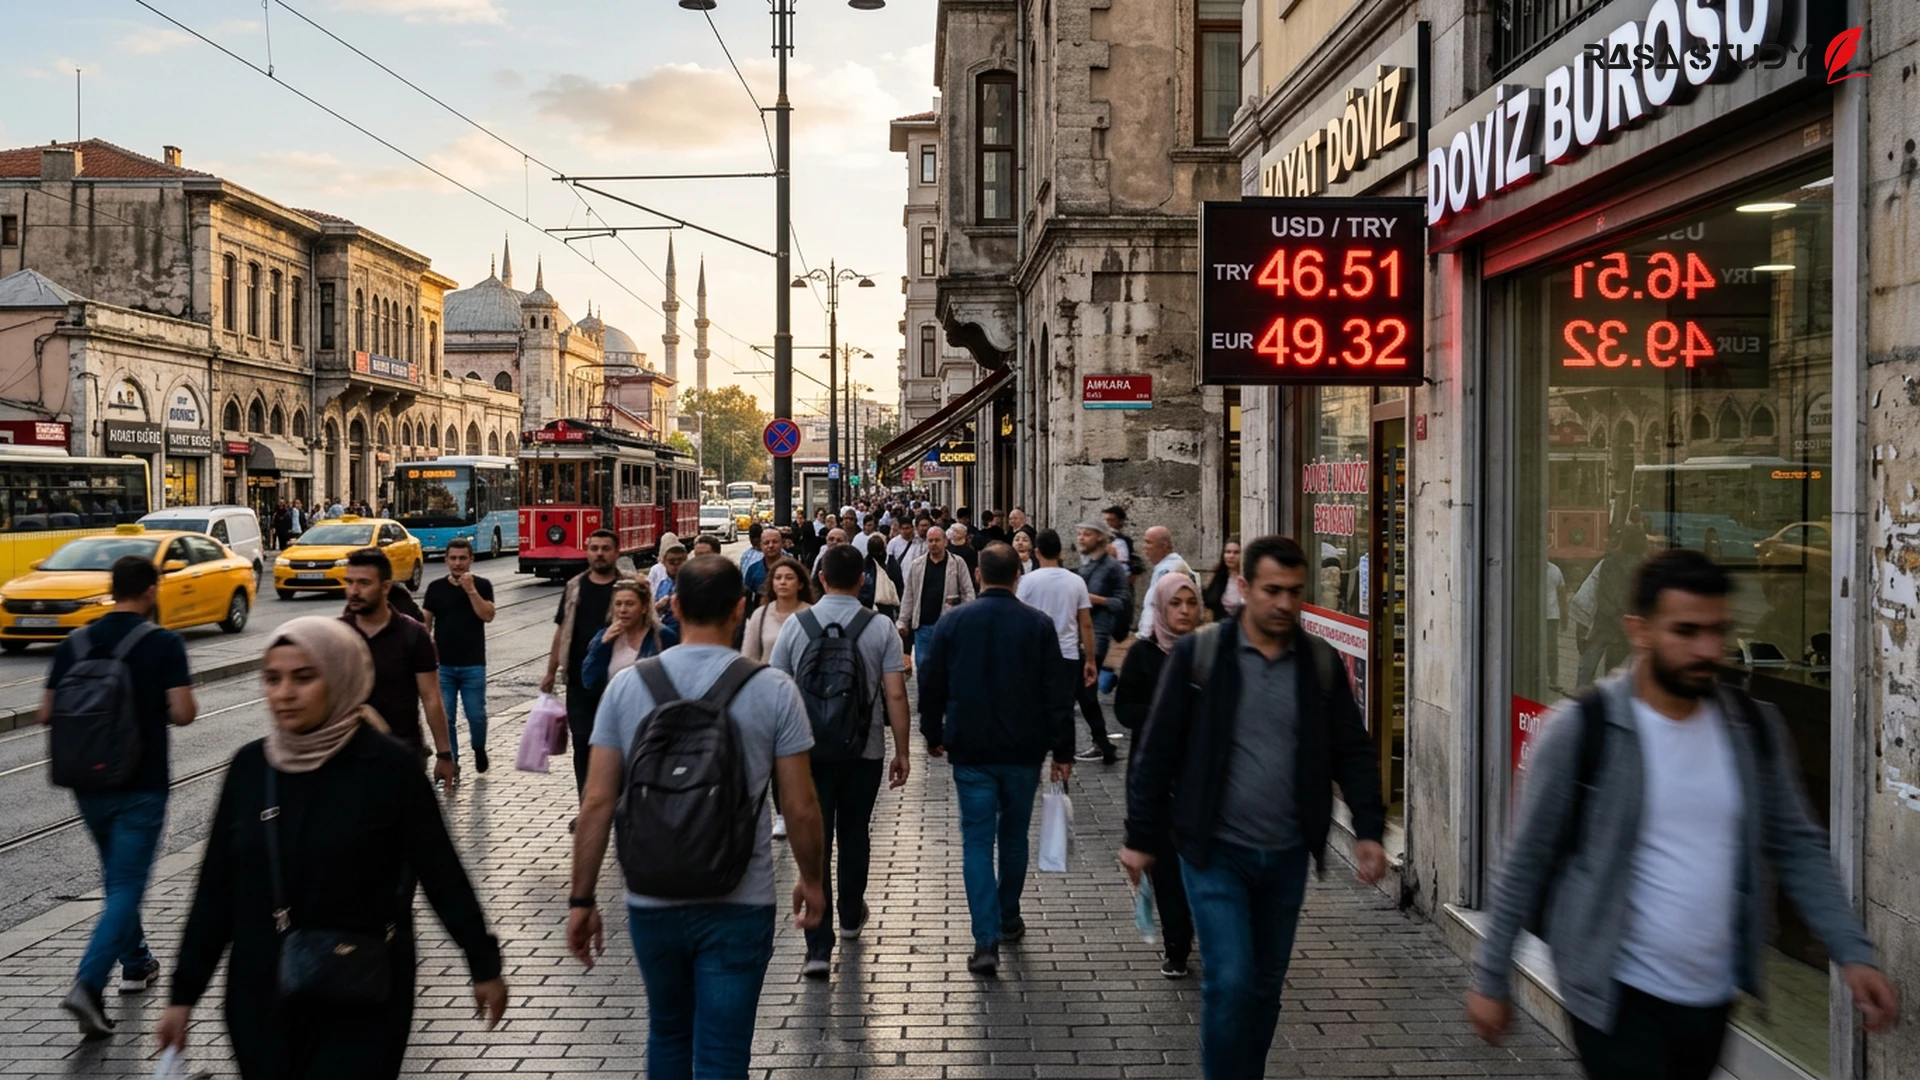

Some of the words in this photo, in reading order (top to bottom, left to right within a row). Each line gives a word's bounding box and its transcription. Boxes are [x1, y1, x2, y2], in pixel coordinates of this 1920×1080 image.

[1263, 130, 1321, 197] HAYAT
[1327, 65, 1401, 184] DÖVİZ
[1271, 216, 1325, 238] USD
[1331, 217, 1340, 238] /
[1347, 217, 1398, 238] TRY
[1213, 264, 1254, 281] TRY
[1257, 249, 1399, 297] 46.51
[1212, 333, 1254, 349] EUR
[1257, 317, 1407, 365] 49.32
